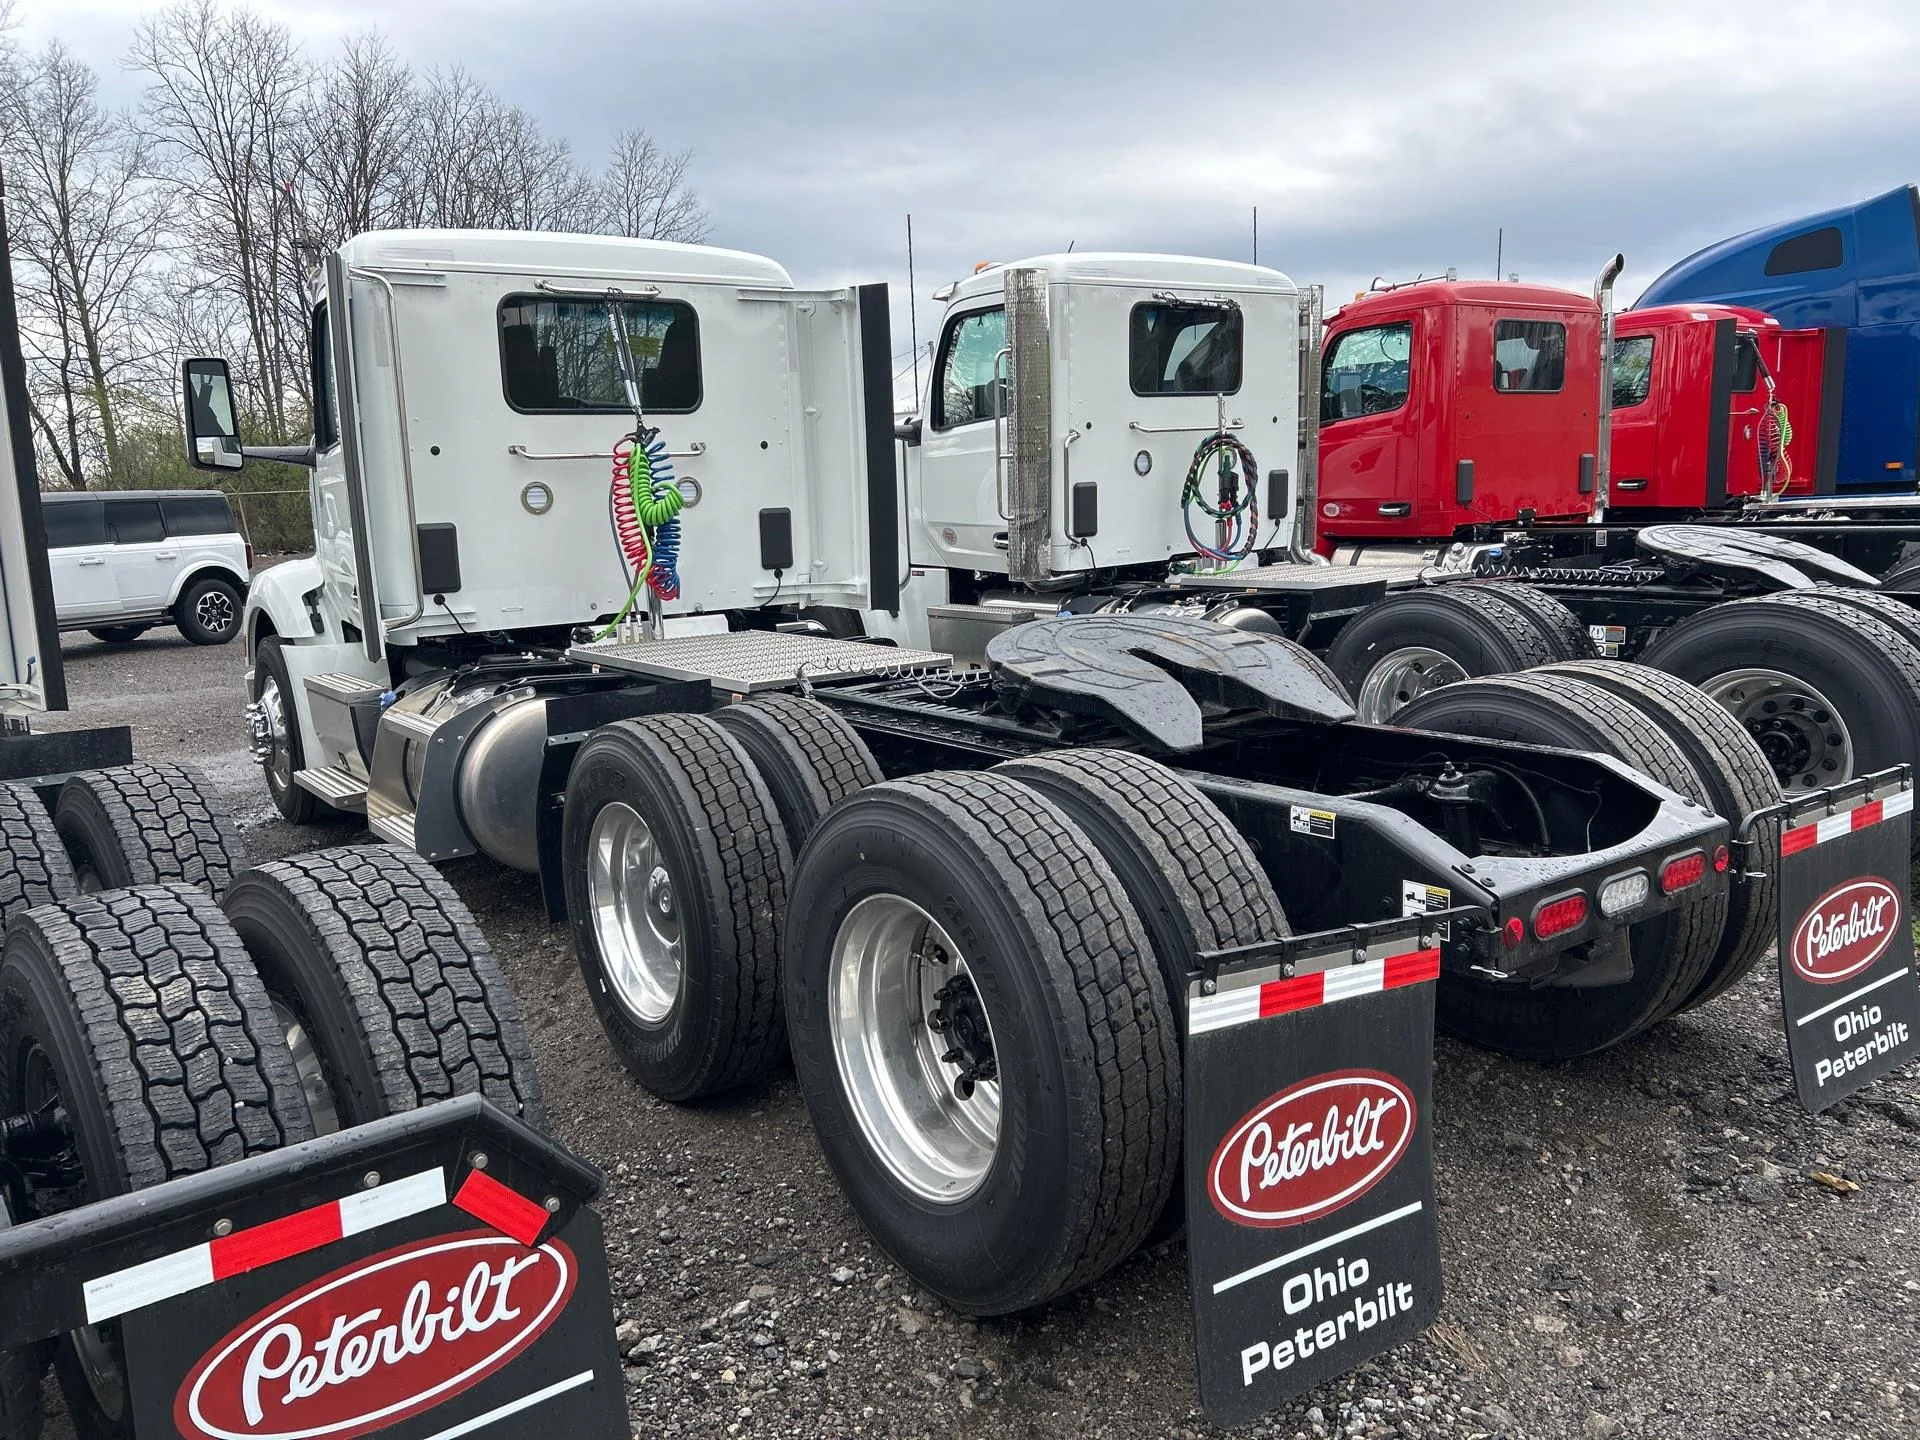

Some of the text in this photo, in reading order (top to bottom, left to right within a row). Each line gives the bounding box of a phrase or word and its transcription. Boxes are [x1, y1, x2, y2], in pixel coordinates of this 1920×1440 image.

[1807, 896, 1890, 966] Peterbilt
[1815, 1022, 1908, 1087] Peterbilt
[1834, 1005, 1882, 1042] Ohio
[1240, 1097, 1397, 1203] Peterbilt
[1282, 1258, 1370, 1316] Ohio
[242, 1253, 541, 1427] Peterbilt
[1241, 1281, 1414, 1386] Peterbilt
